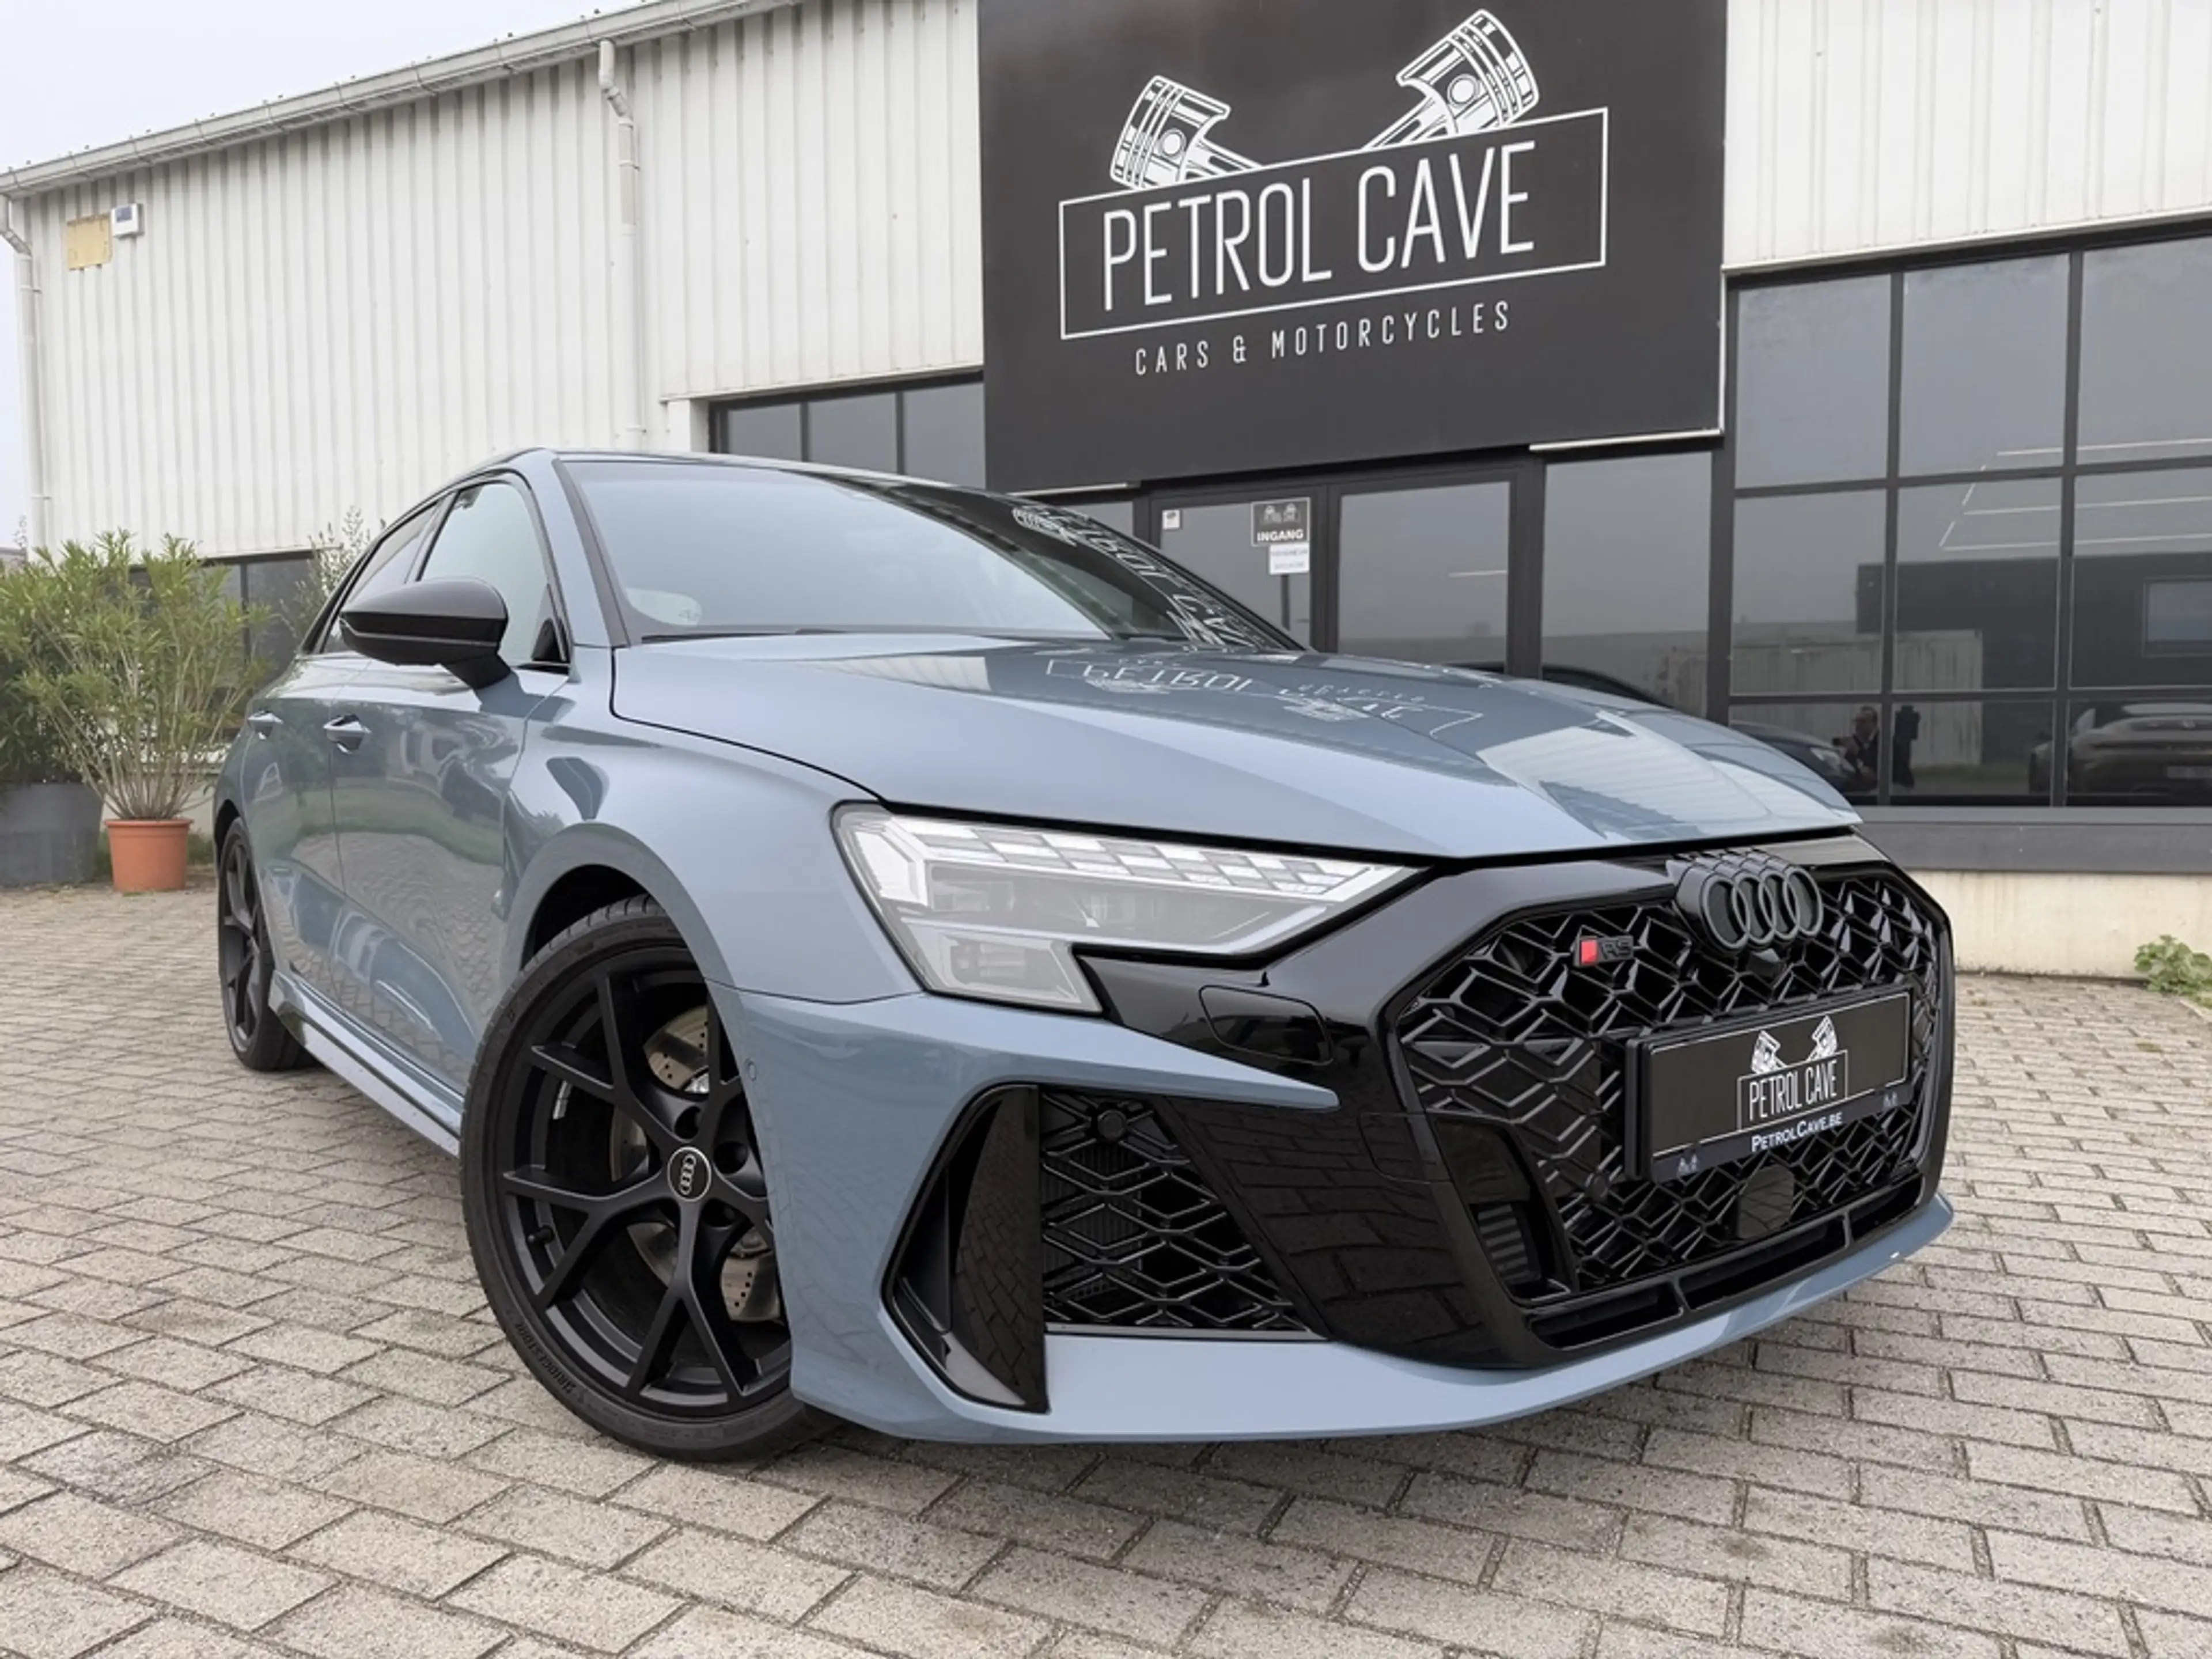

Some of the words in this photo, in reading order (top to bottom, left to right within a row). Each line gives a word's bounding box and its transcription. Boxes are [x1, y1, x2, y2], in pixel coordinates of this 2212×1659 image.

[1104, 178, 1332, 310] PETROL
[1358, 141, 1535, 272] CAVE
[1136, 340, 1208, 375] CARS
[1233, 335, 1246, 363] &
[1272, 300, 1508, 358] MOTORCYCLES
[1256, 528, 1304, 542] INGANG
[1749, 1070, 1802, 1121] PETROL
[1805, 1059, 1838, 1105] CAVE
